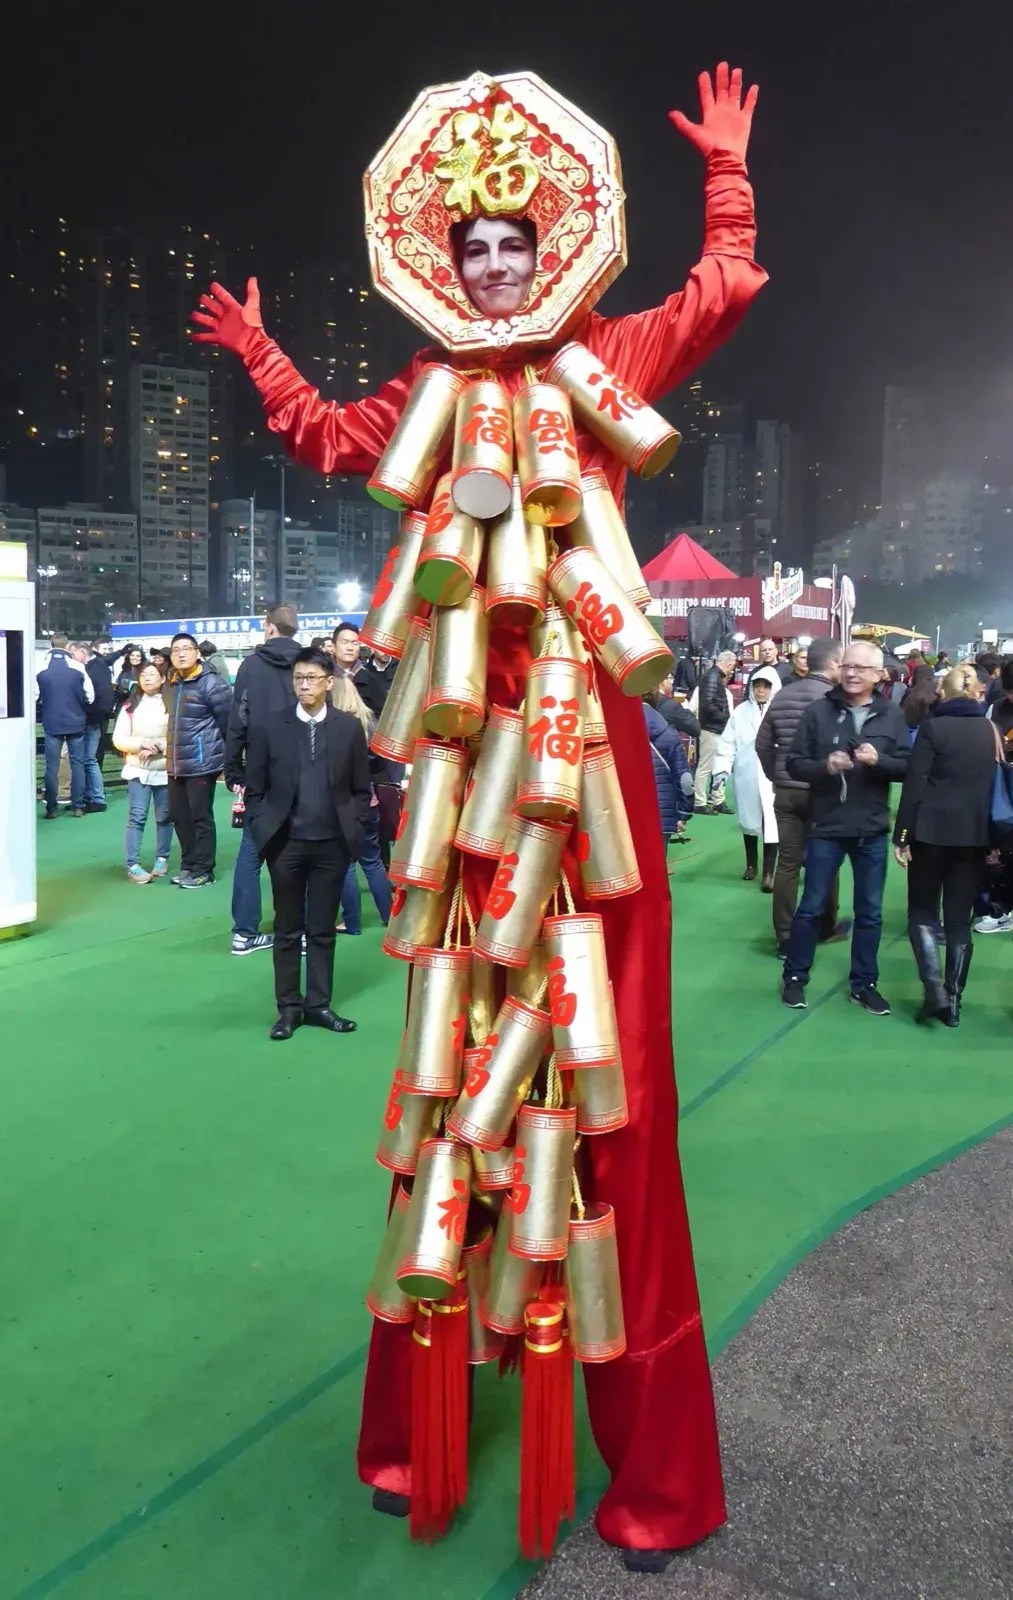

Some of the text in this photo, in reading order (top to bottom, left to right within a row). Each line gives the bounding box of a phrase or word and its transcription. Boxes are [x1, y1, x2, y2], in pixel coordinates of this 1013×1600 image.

[434, 101, 540, 216] 福
[462, 403, 512, 455] 福
[528, 696, 582, 766] 福
